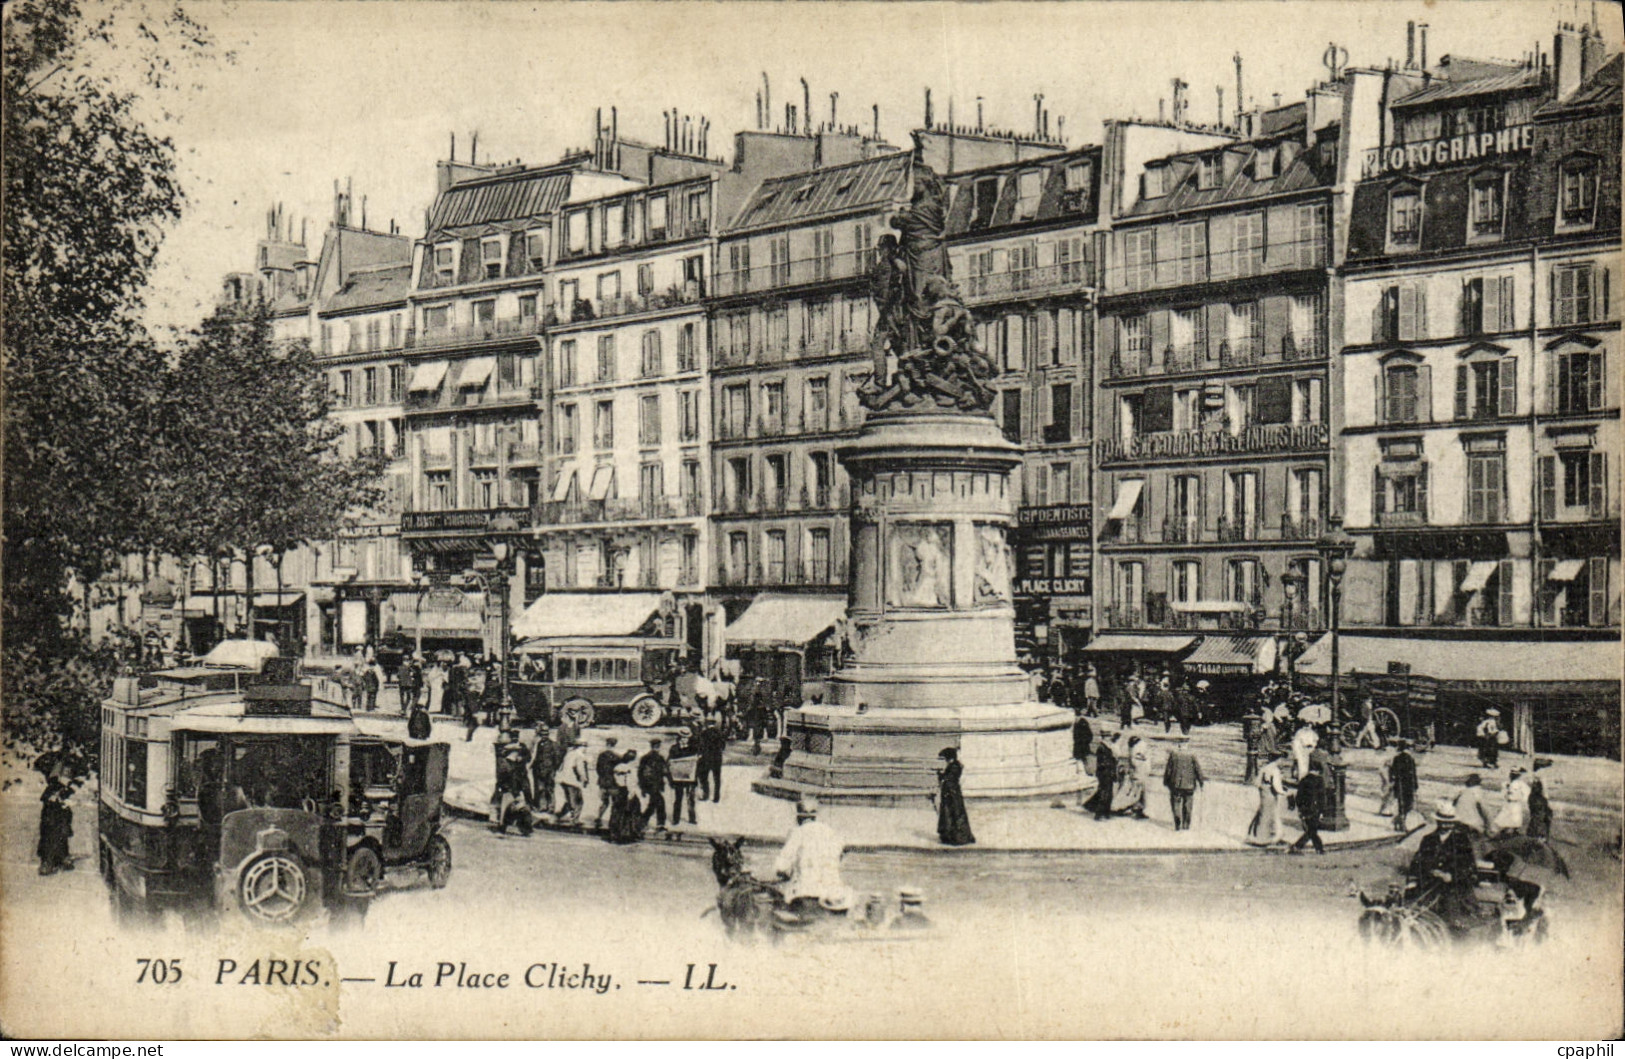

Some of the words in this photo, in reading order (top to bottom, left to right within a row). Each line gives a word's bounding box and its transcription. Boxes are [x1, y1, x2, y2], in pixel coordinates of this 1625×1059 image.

[1363, 127, 1533, 175] PHOTOGRAPHIE
[1038, 507, 1091, 521] DENTISTE
[1022, 579, 1050, 593] PLACE
[1053, 579, 1084, 593] CLICHY
